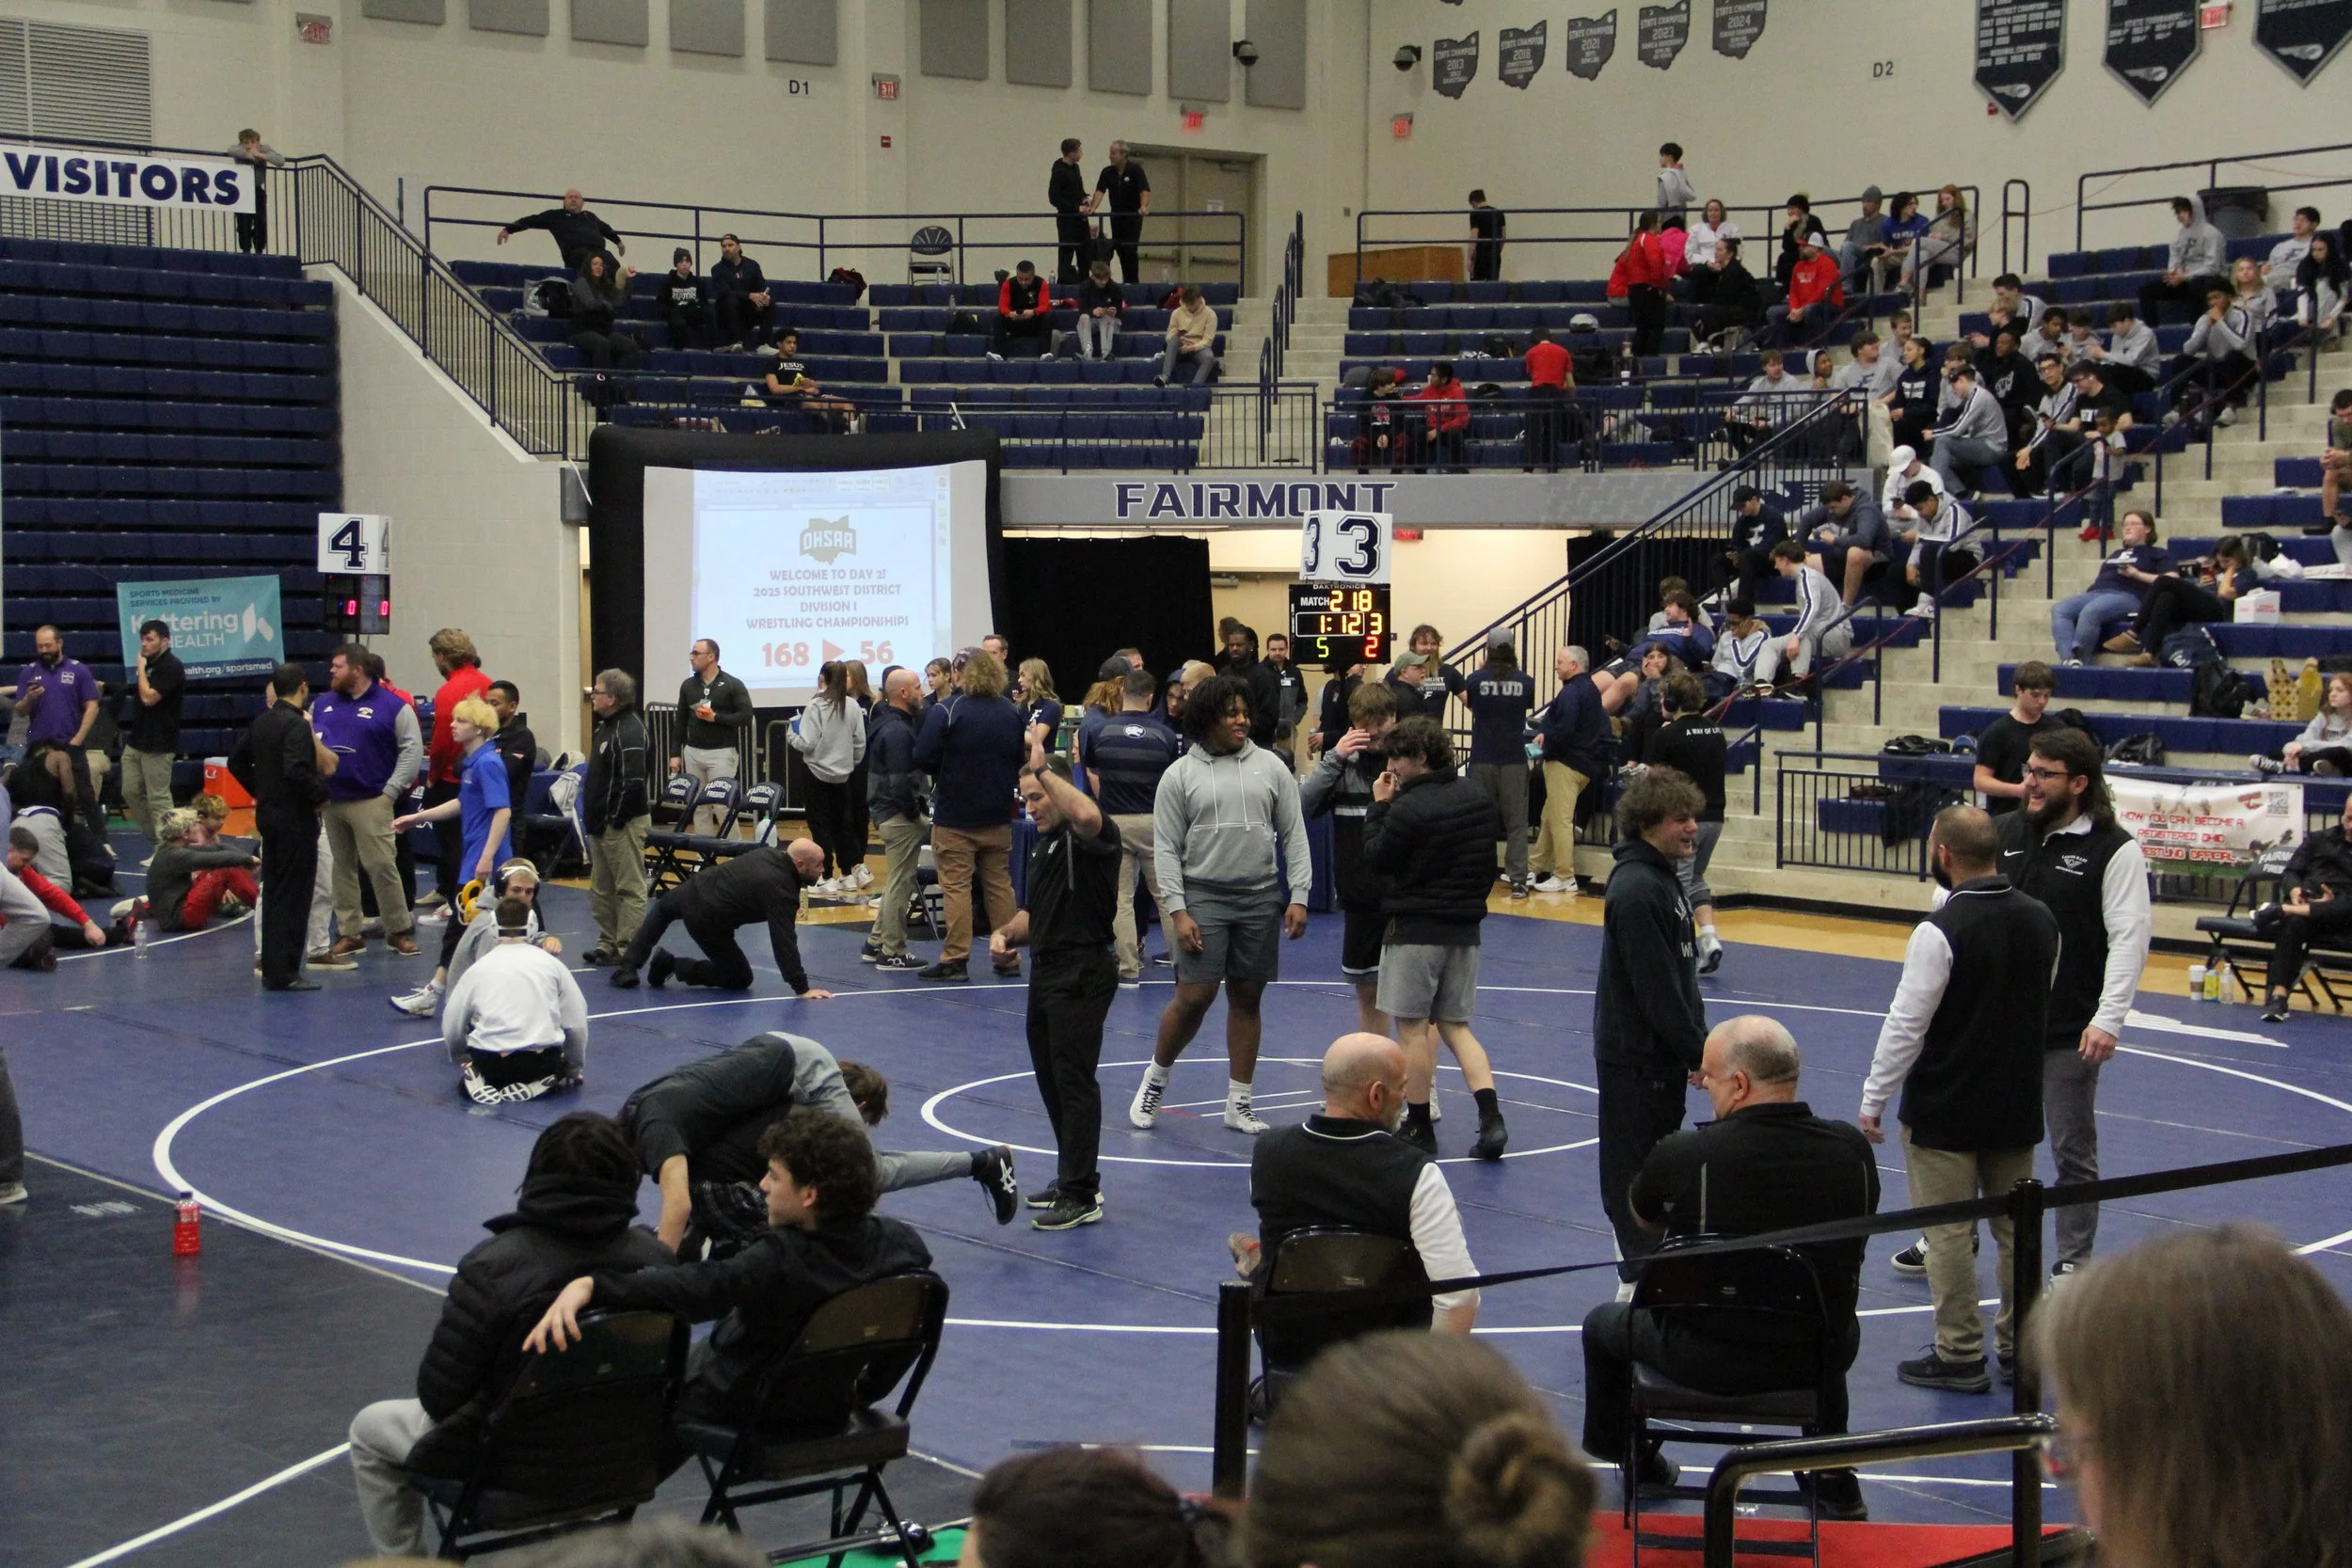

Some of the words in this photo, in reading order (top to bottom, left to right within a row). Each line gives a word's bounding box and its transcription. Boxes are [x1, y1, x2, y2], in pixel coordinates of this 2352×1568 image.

[1727, 15, 1752, 29] 2024
[1652, 26, 1675, 40] 2023
[1873, 61, 1894, 77] D2
[789, 80, 809, 95] D1
[3, 151, 241, 206] VISITORS
[1114, 482, 1398, 518] FAIRMONT
[327, 517, 369, 570] 4
[803, 529, 855, 550] OHSAA
[1304, 514, 1322, 576] 3
[1334, 515, 1381, 578] 3
[770, 569, 829, 581] WELCOME
[831, 569, 847, 580] TO
[850, 568, 874, 580] DAY
[130, 590, 160, 598] SPORTS
[162, 587, 200, 595] MEDICINE
[754, 586, 780, 597] 2025
[783, 585, 850, 596] SOUTHWEST
[853, 583, 901, 595] DISTRICT
[131, 598, 167, 608] SERVICES
[169, 596, 211, 607] PROVIDED
[212, 595, 222, 604] BY
[800, 601, 851, 612] DIVISION
[1300, 596, 1330, 607] MATCH
[746, 617, 813, 629] WRESTLING
[816, 616, 910, 628] CHAMPIONSHIPS
[1320, 612, 1361, 635] 1:12
[1370, 612, 1383, 635] 3
[762, 641, 810, 667] 168
[860, 640, 894, 665] 56
[1316, 636, 1329, 658] 5
[1364, 636, 1378, 657] 2
[1479, 680, 1524, 697] STUD
[2120, 811, 2145, 822] HOW
[2148, 812, 2167, 823] YOU
[2169, 815, 2190, 825] CAN
[2194, 816, 2234, 827] BECOME
[2236, 817, 2244, 827] A
[2137, 829, 2198, 841] REGISTERED
[2201, 832, 2226, 844] OHIO
[2141, 846, 2185, 860] ESTLING
[2189, 848, 2236, 863] OFFICIAL
